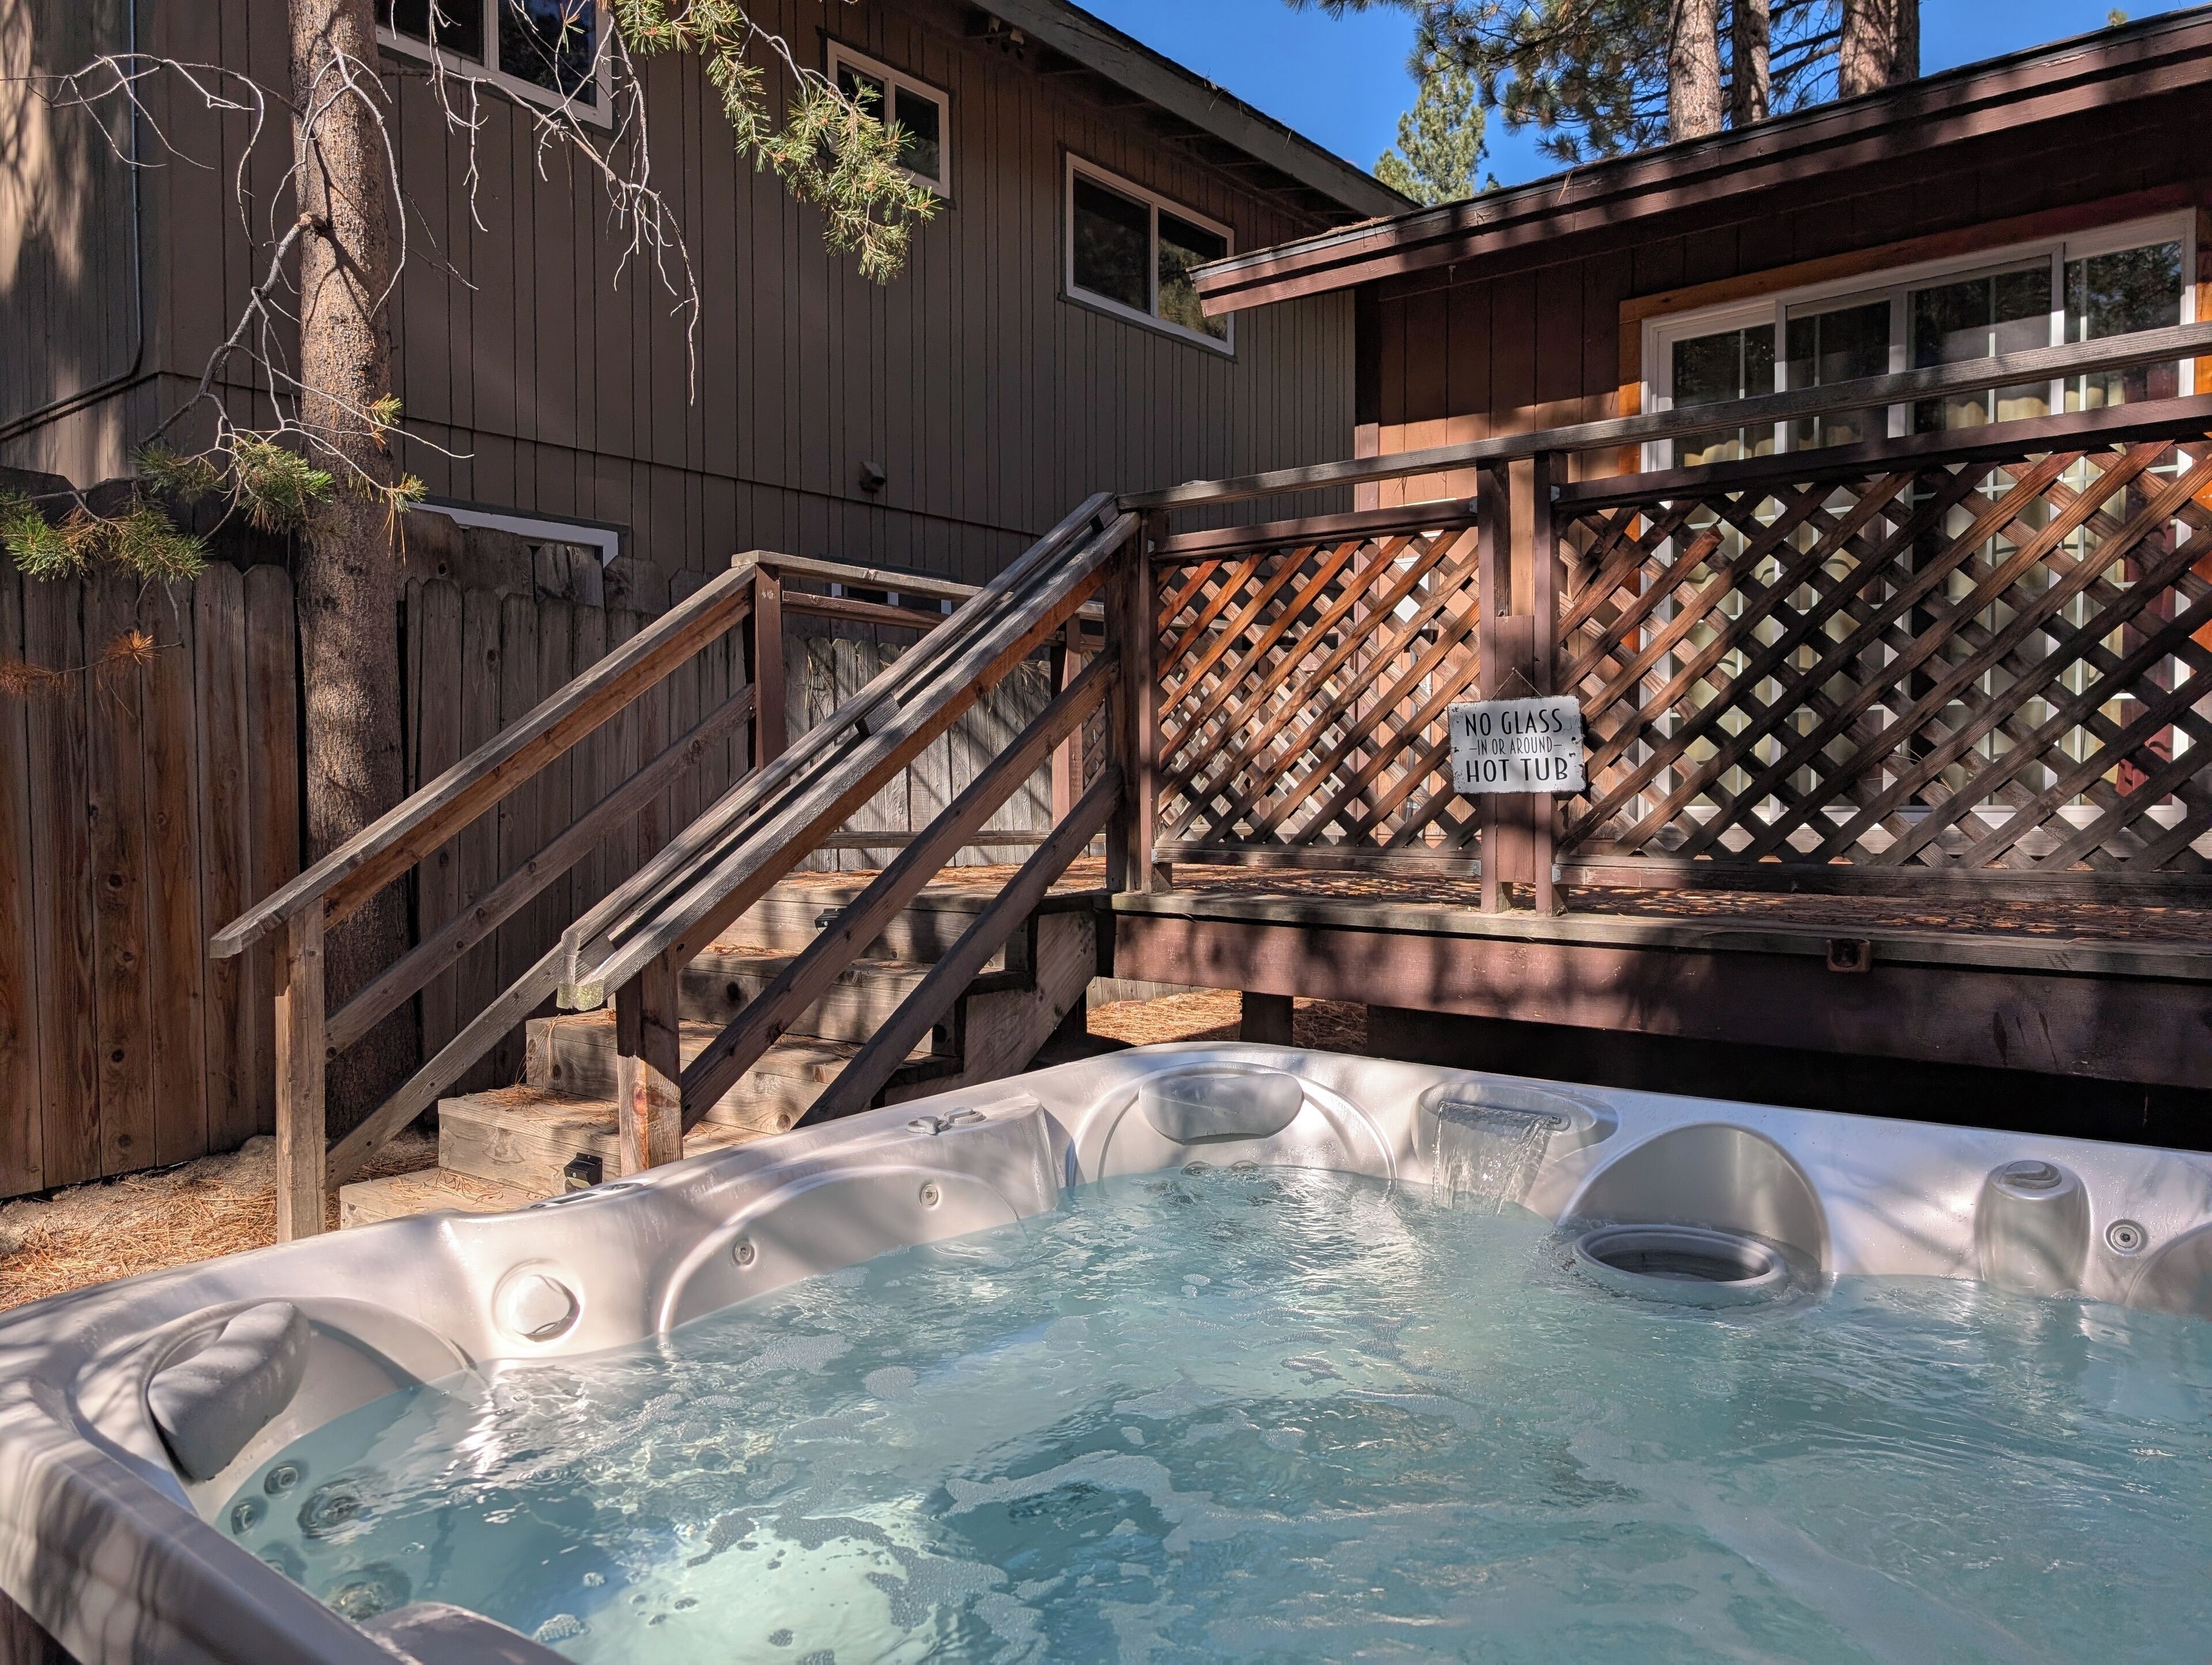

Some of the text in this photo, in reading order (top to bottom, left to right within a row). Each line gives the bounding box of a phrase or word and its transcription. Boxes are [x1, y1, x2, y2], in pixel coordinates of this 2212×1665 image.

[1465, 708, 1563, 737] NO GLASS
[1492, 738, 1506, 755] OR
[1466, 757, 1568, 783] HOT TUB
